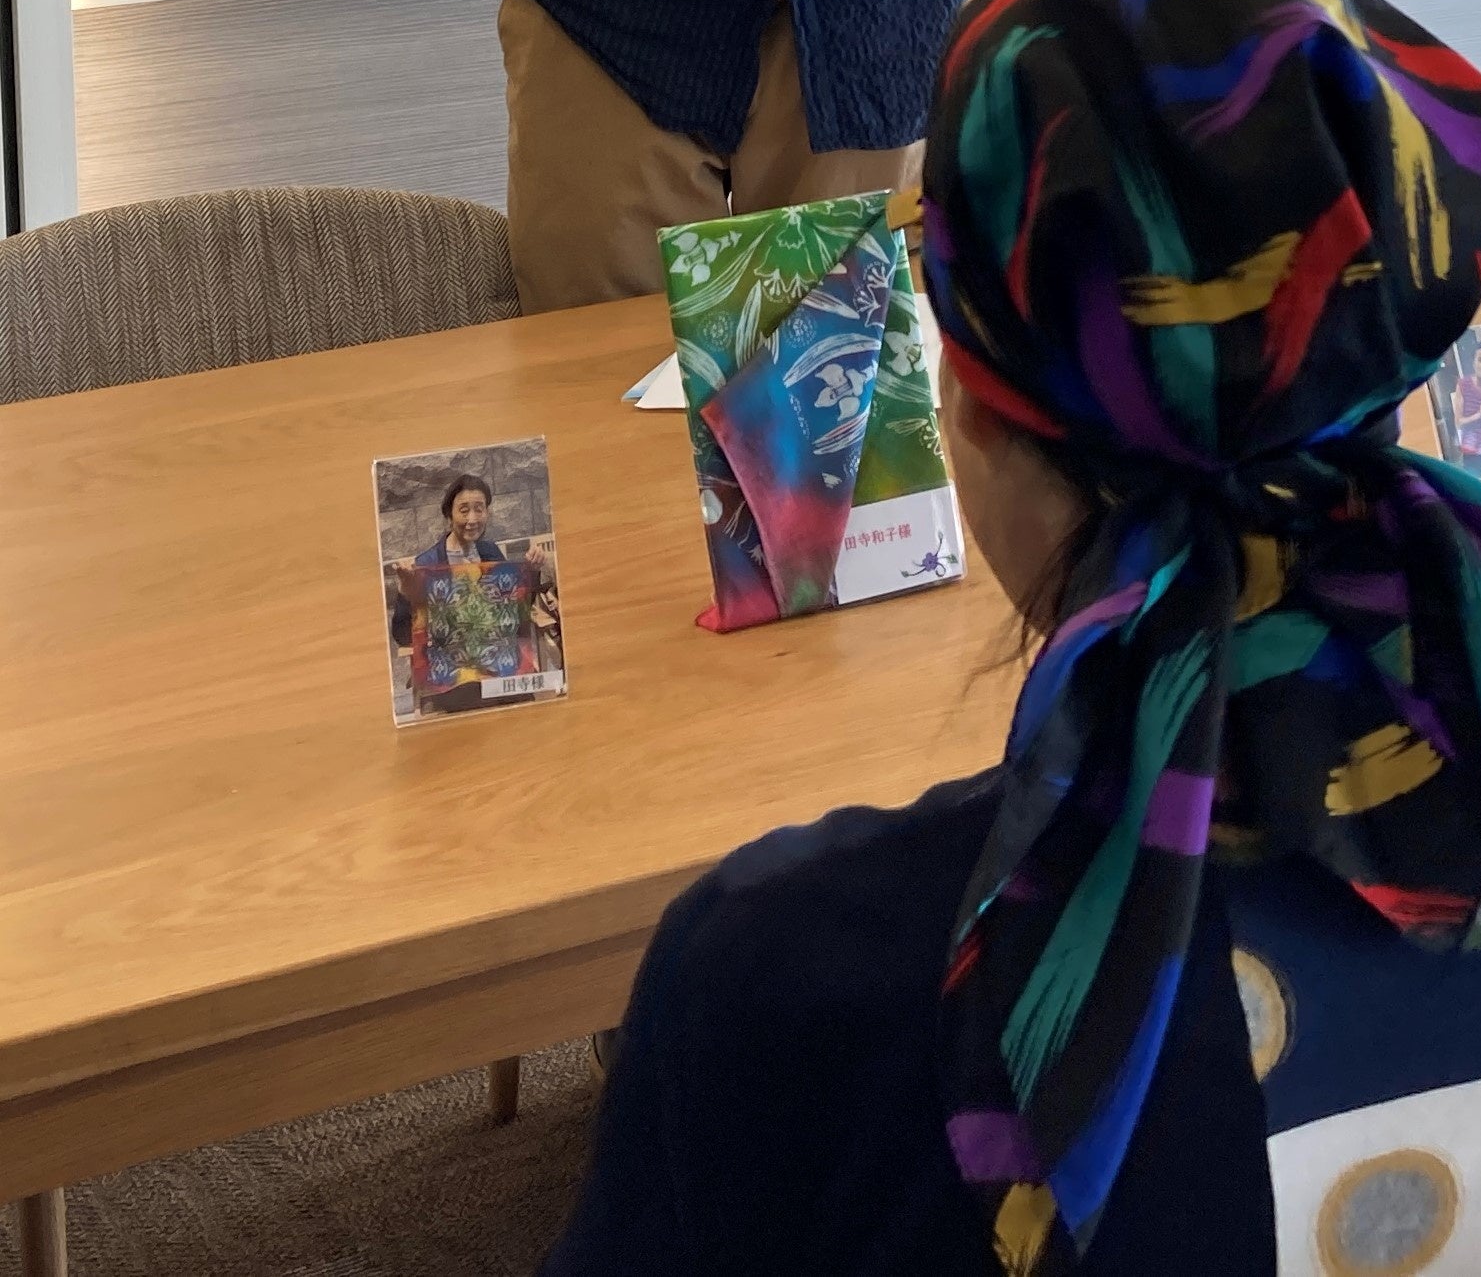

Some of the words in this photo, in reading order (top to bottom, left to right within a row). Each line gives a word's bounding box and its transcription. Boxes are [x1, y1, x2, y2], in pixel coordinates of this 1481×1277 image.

[844, 523, 912, 551] 田寺和子様
[502, 674, 545, 694] 田寺様
